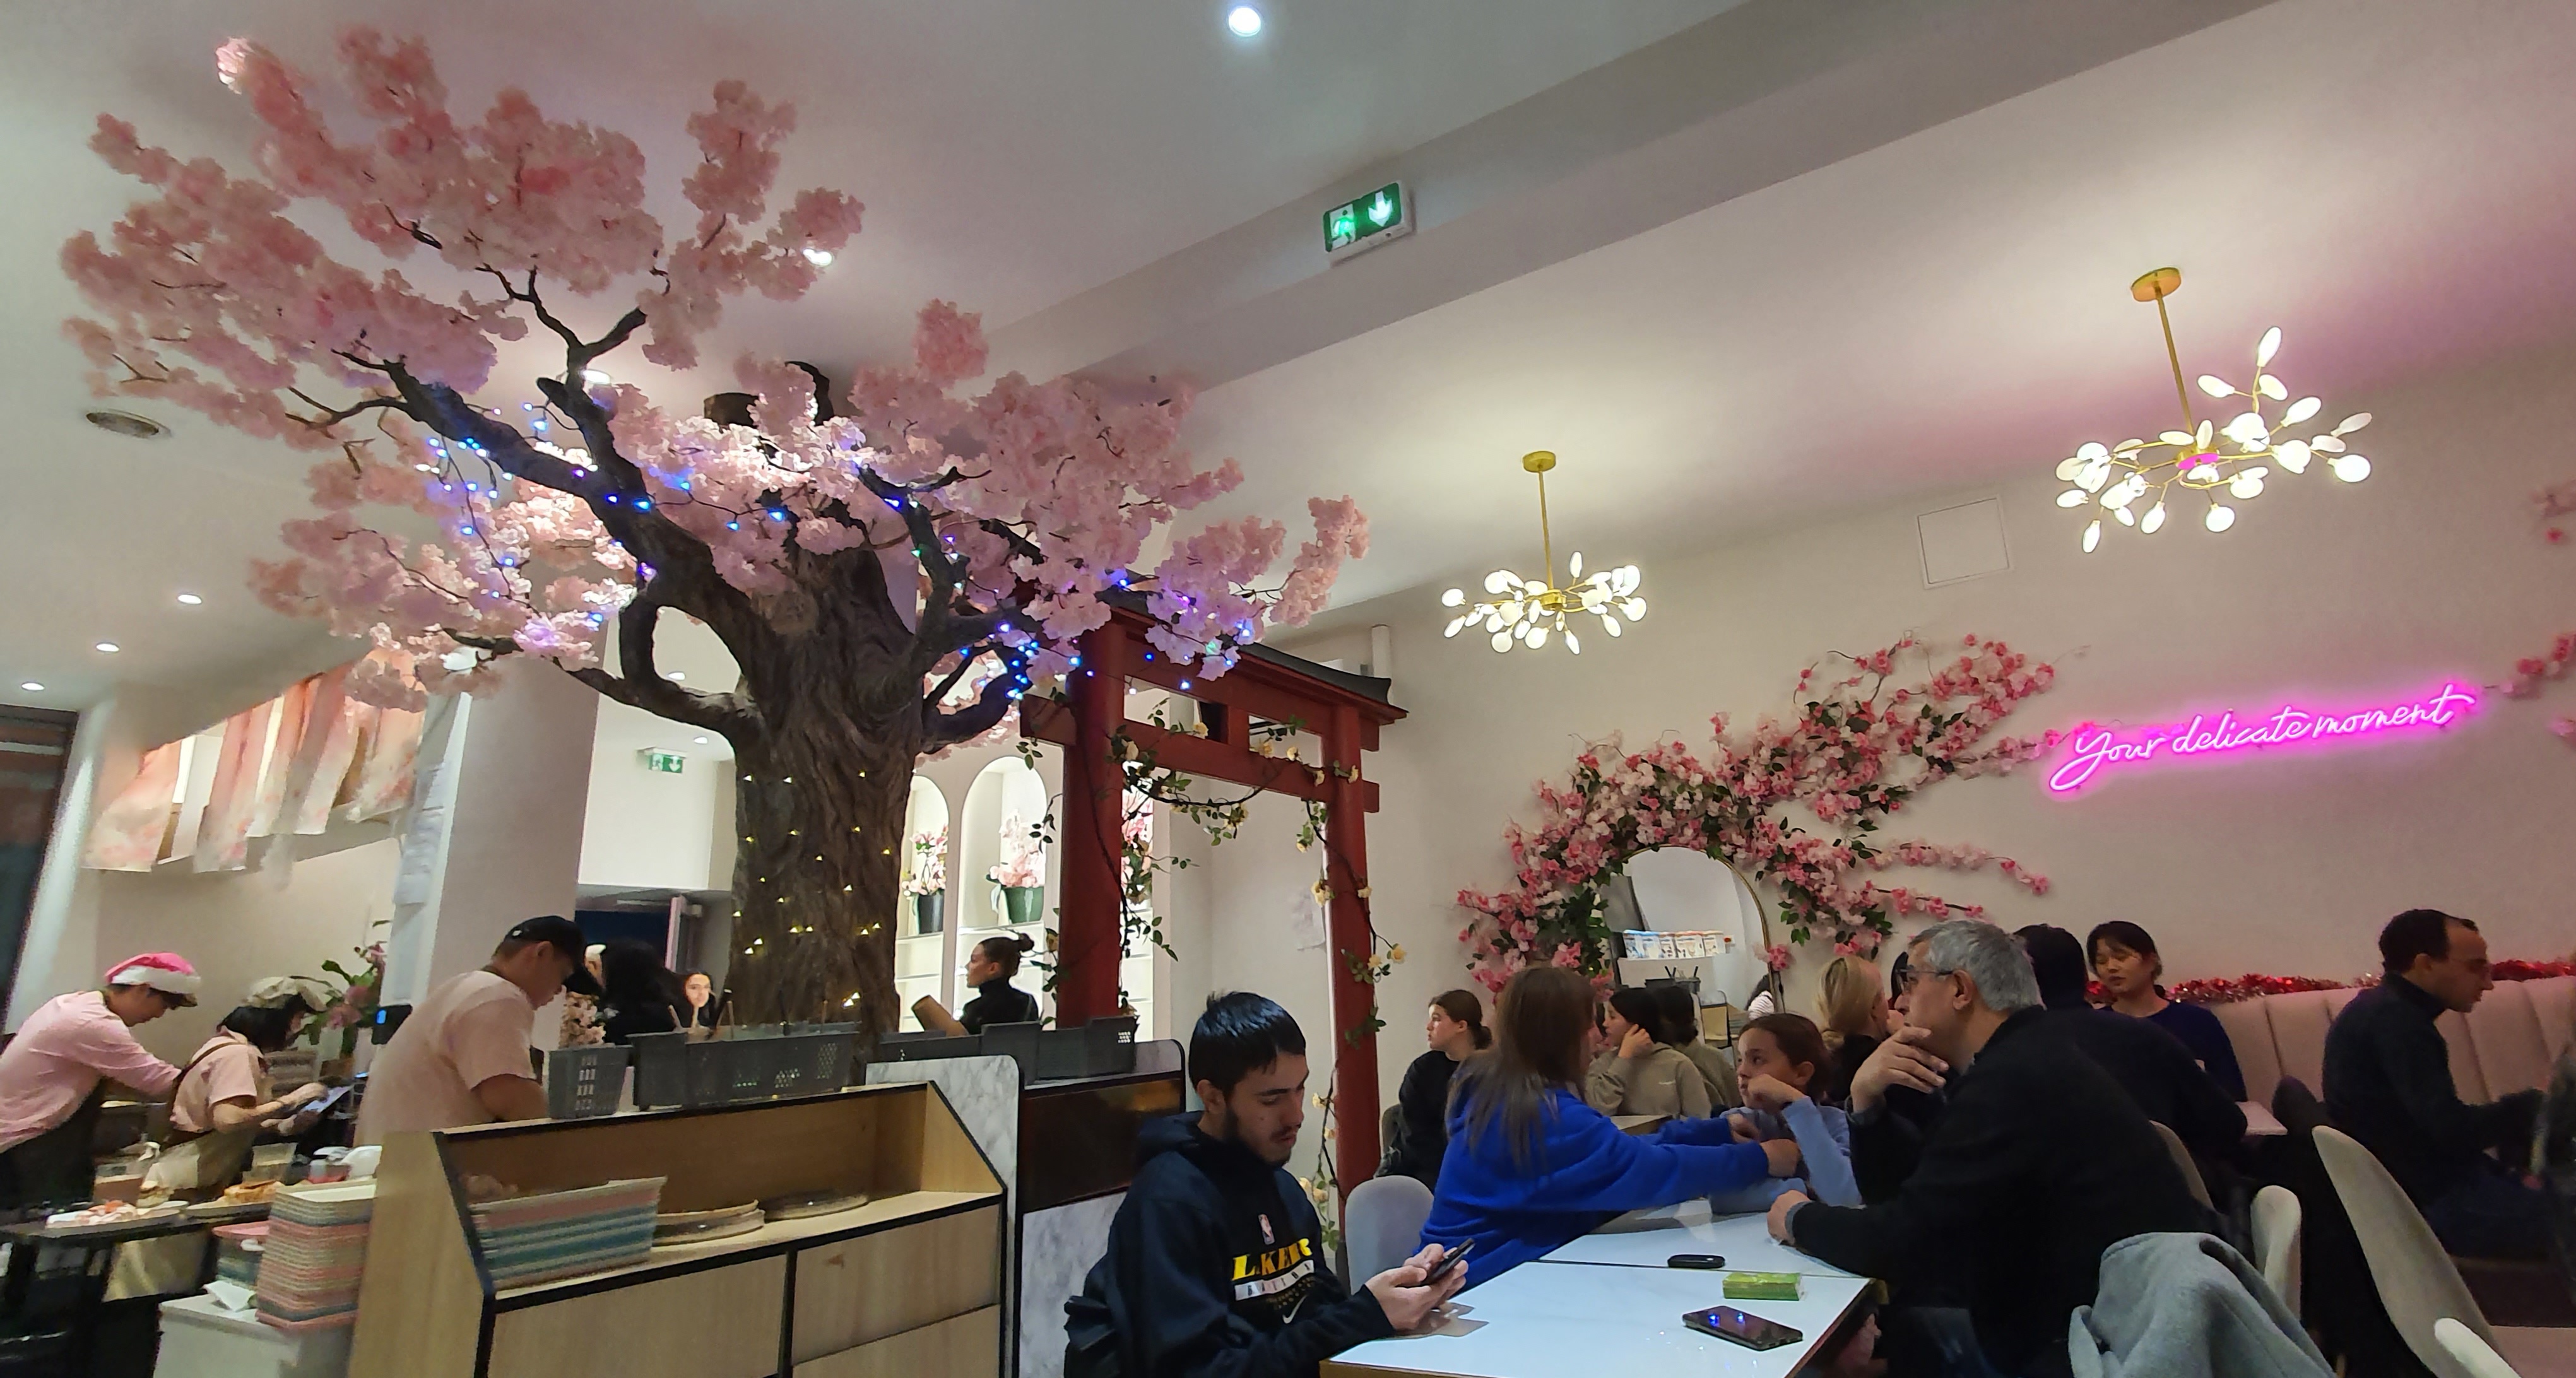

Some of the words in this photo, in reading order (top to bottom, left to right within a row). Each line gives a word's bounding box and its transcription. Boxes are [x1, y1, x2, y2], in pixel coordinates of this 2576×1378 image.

[2049, 731, 2167, 791] Your
[2171, 705, 2313, 753] delicate
[2311, 683, 2476, 739] moment
